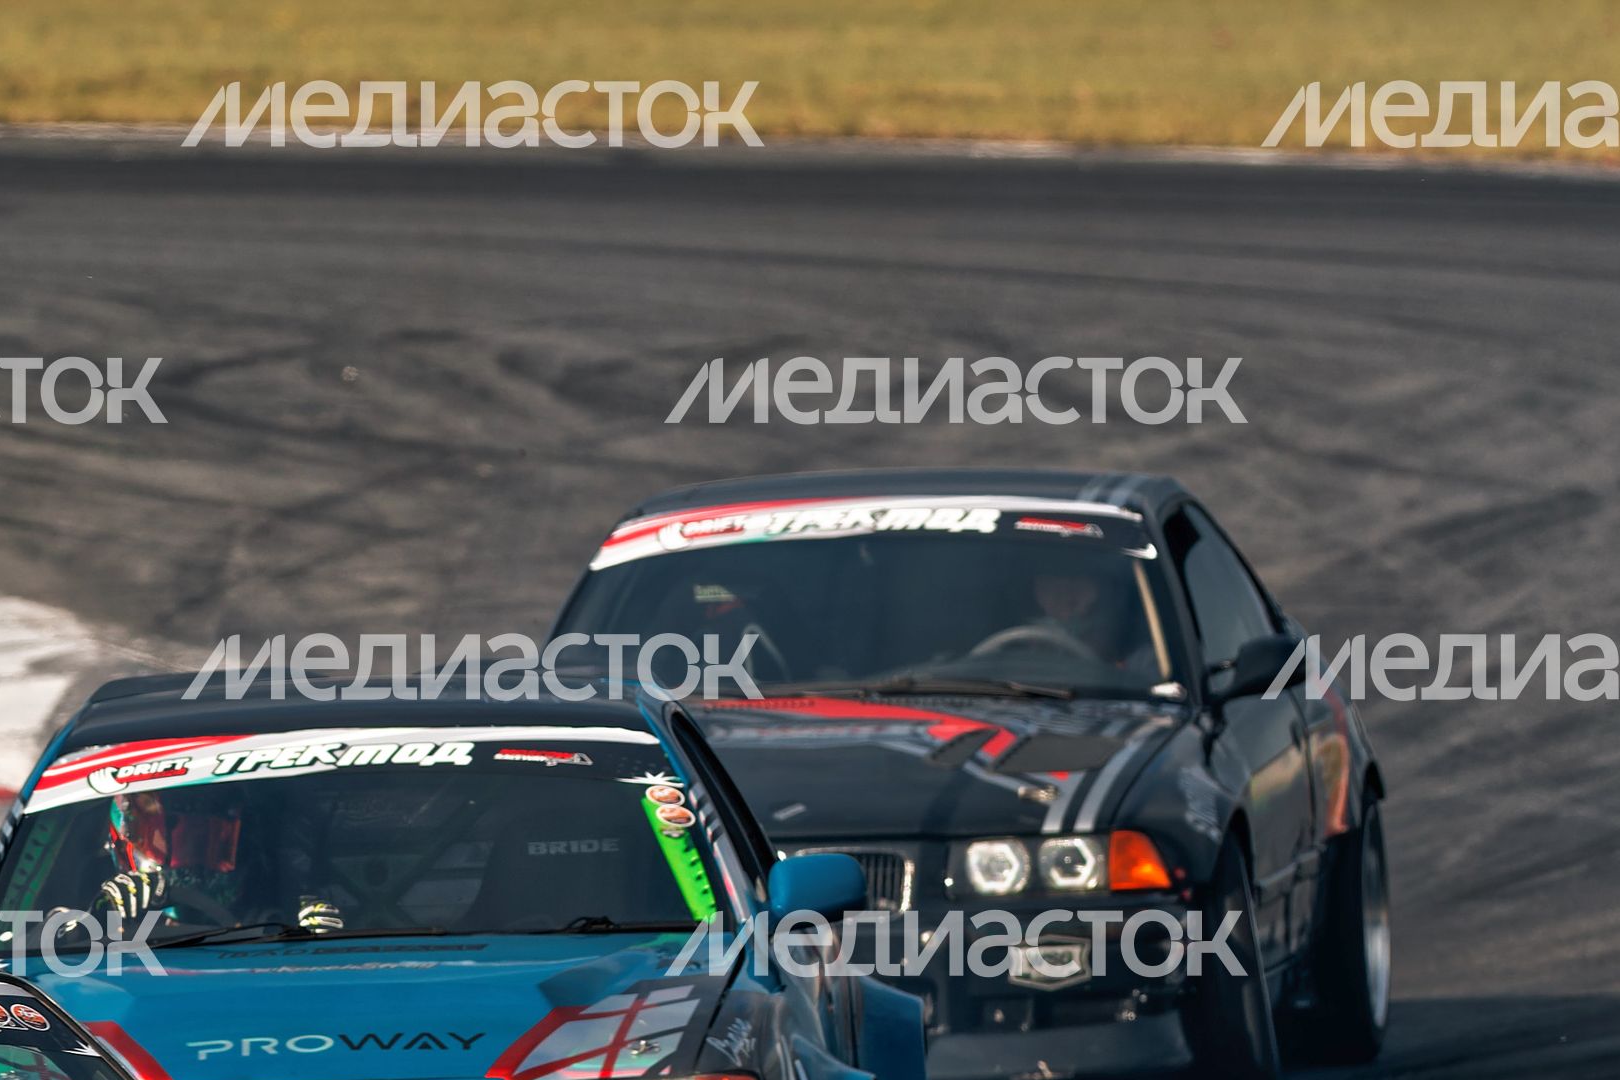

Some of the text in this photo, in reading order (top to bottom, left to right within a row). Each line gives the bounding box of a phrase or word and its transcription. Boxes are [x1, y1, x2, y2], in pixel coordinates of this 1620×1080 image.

[117, 757, 191, 778] DRIFT
[527, 839, 620, 855] BRIDE
[186, 1032, 487, 1061] PROWAY
